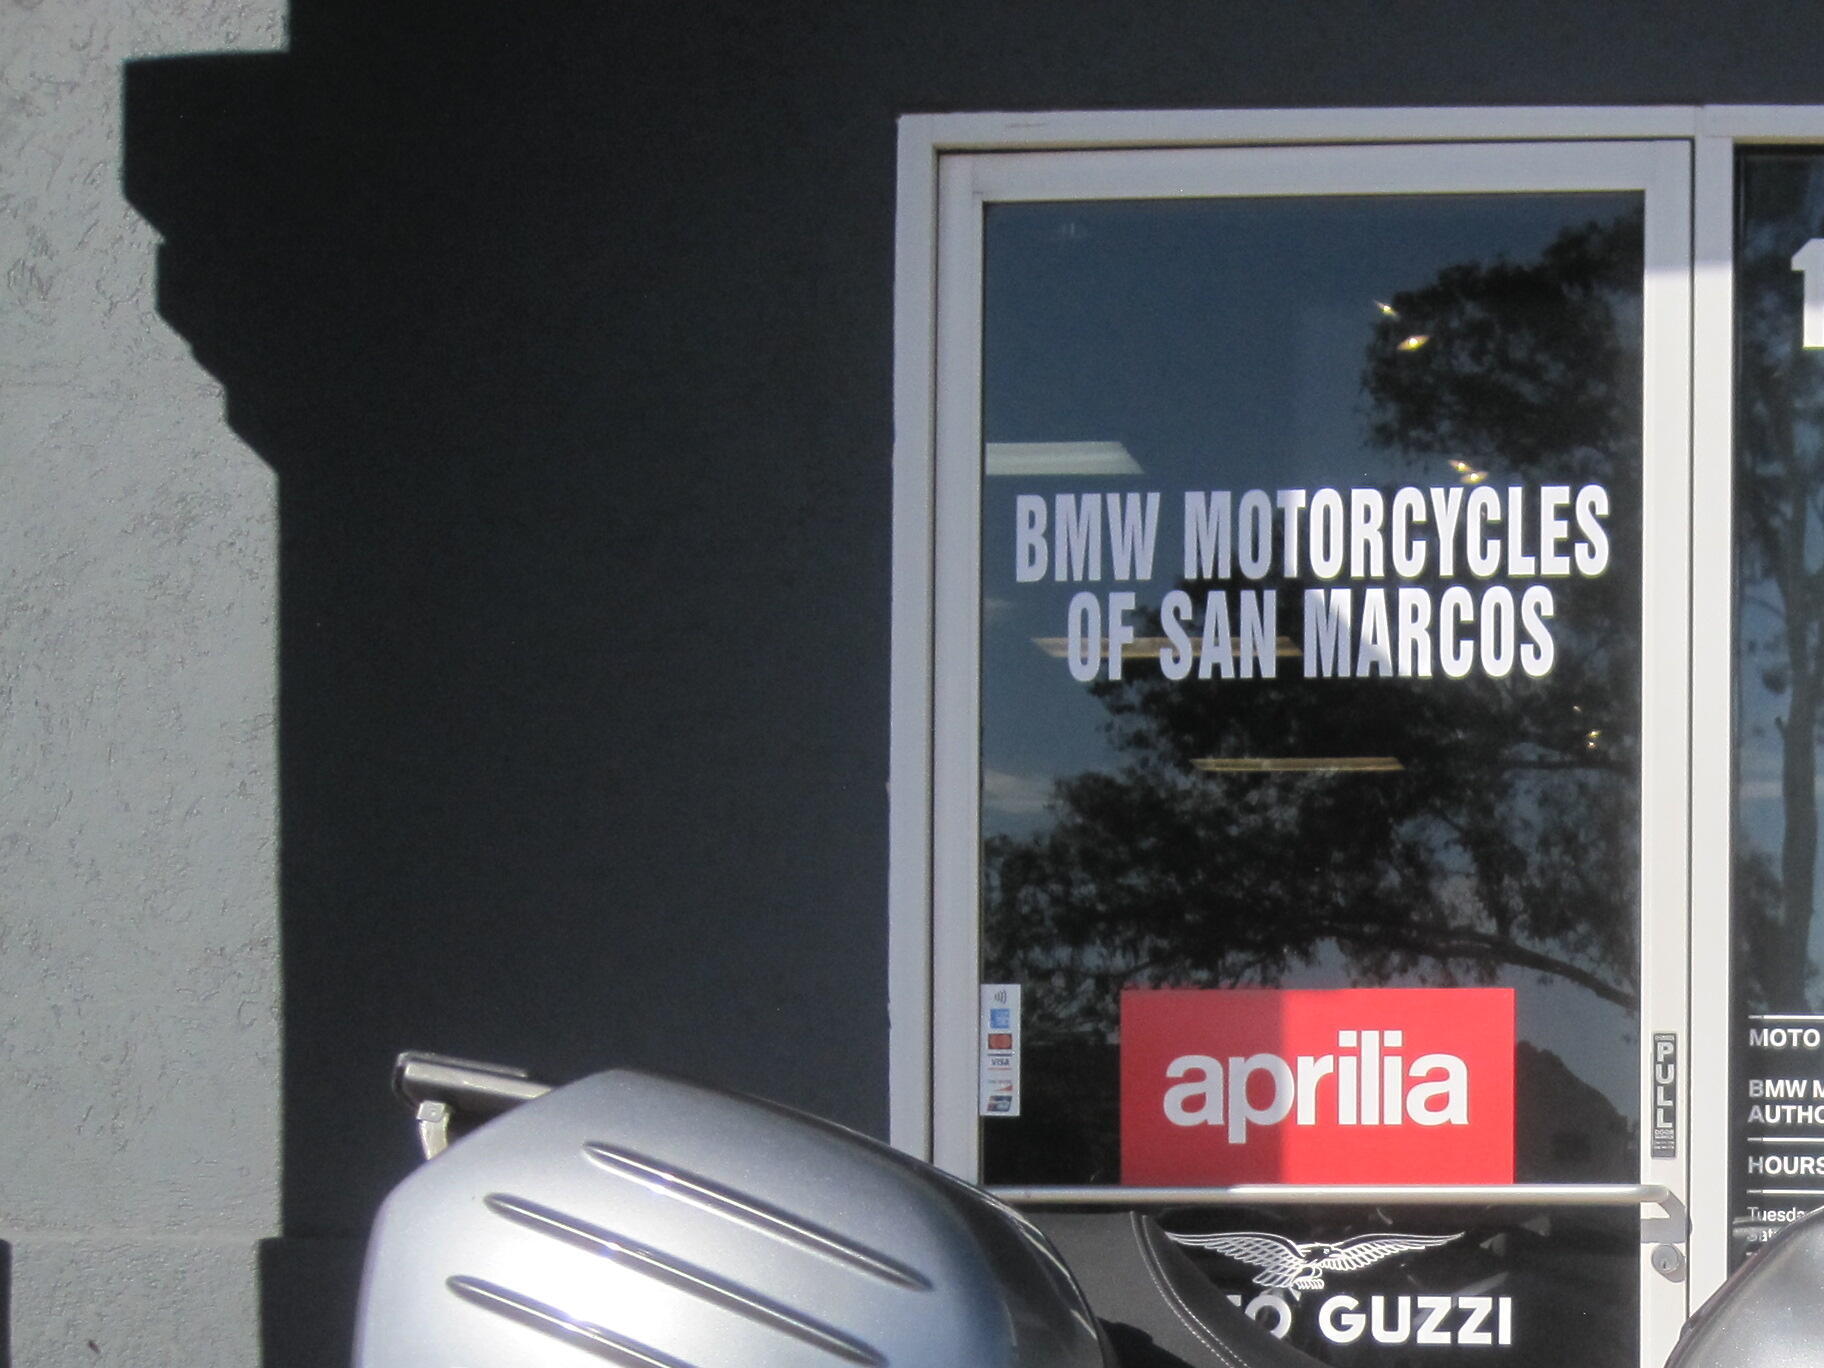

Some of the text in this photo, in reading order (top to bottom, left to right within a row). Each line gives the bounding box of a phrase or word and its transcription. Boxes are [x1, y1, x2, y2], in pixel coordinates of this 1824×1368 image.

[1015, 484, 1610, 583] BMW MOTORCYCLES
[1066, 586, 1555, 682] OF SAN MARCOS
[1748, 1028, 1821, 1048] MOTO
[1163, 1029, 1470, 1144] aprilia
[1655, 1041, 1675, 1128] PULL
[1748, 1079, 1808, 1098] BMW
[1318, 1294, 1512, 1346] GUZZI
